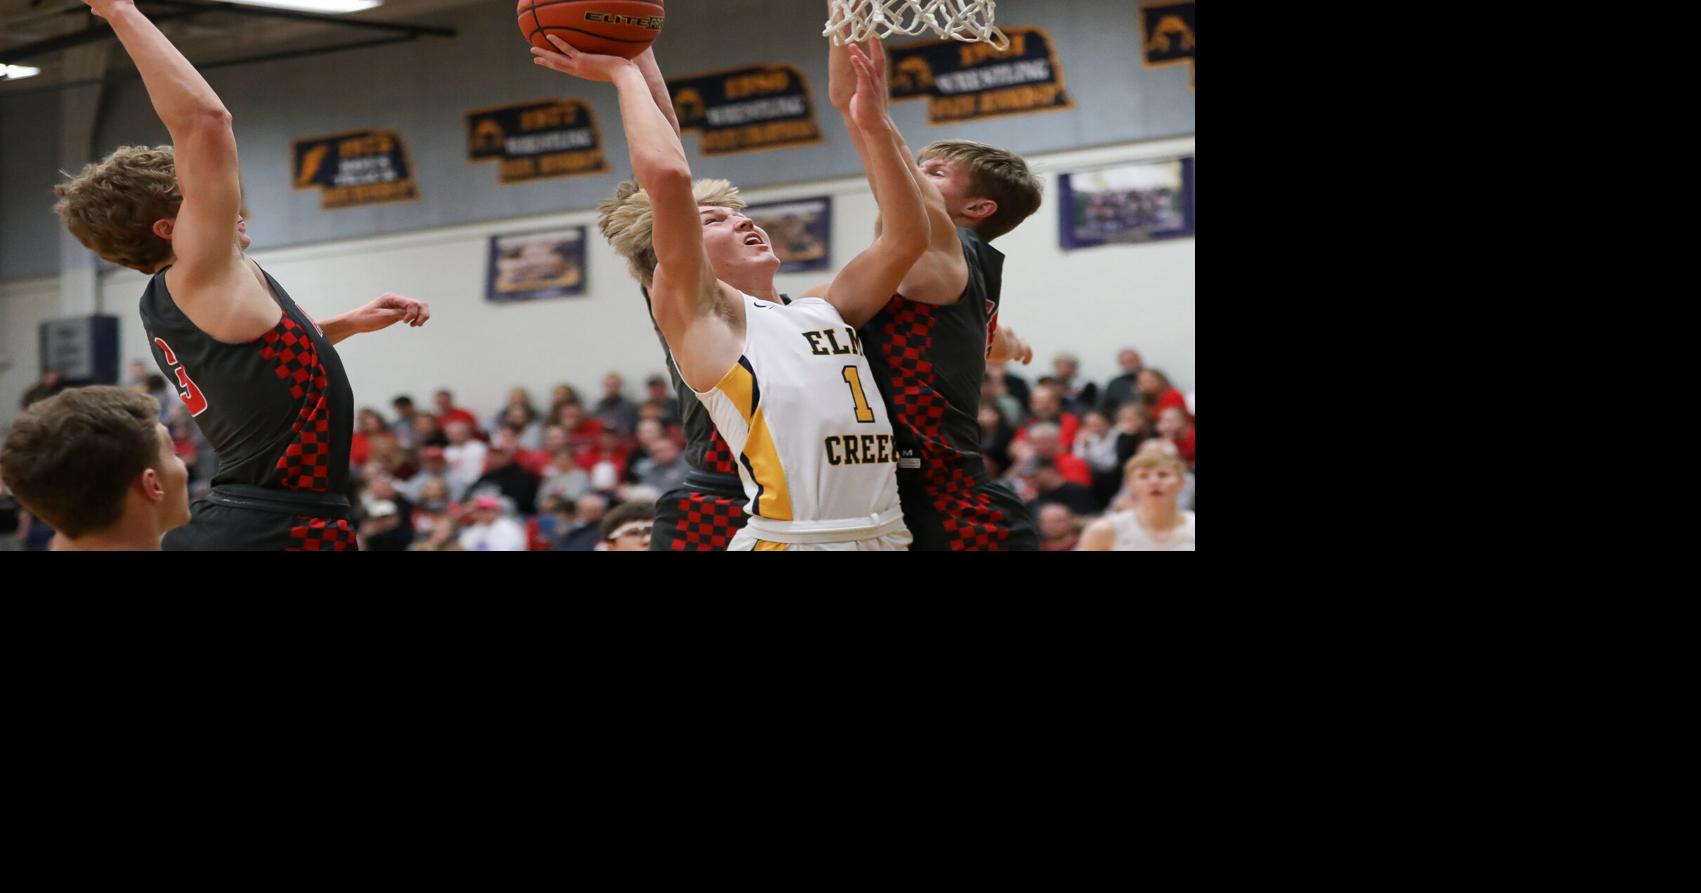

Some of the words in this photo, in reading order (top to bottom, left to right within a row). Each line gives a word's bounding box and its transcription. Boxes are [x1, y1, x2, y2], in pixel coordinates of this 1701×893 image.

[584, 11, 650, 28] ELITE
[934, 60, 1050, 92] WRESTLING
[801, 327, 864, 356] ELM
[842, 365, 876, 423] 1
